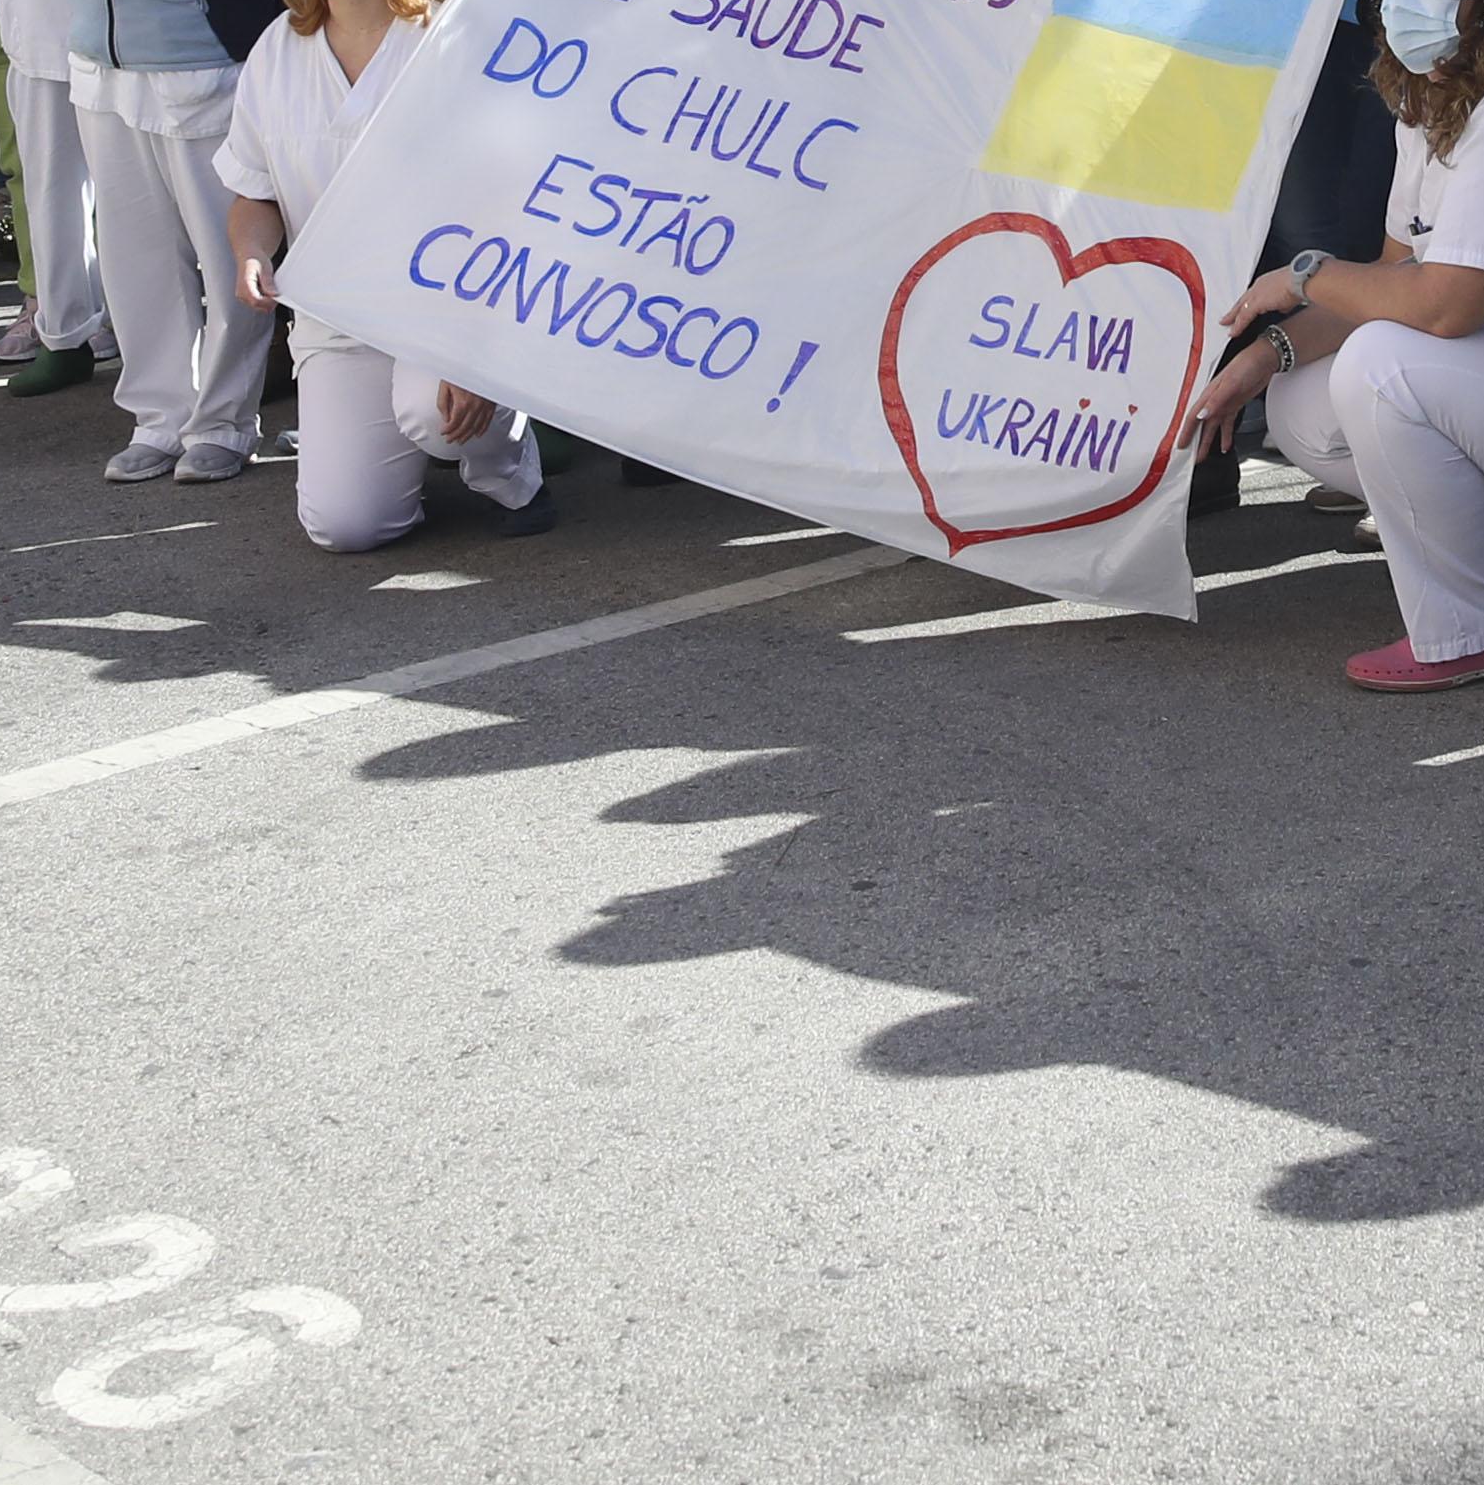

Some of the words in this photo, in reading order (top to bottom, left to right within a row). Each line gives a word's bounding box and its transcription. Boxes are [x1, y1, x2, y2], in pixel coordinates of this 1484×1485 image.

[482, 17, 589, 99] DO
[610, 66, 860, 192] CHULC
[522, 153, 736, 276] ESTÃO
[409, 224, 761, 380] CONVOSCO
[968, 295, 1134, 374] SLAVA
